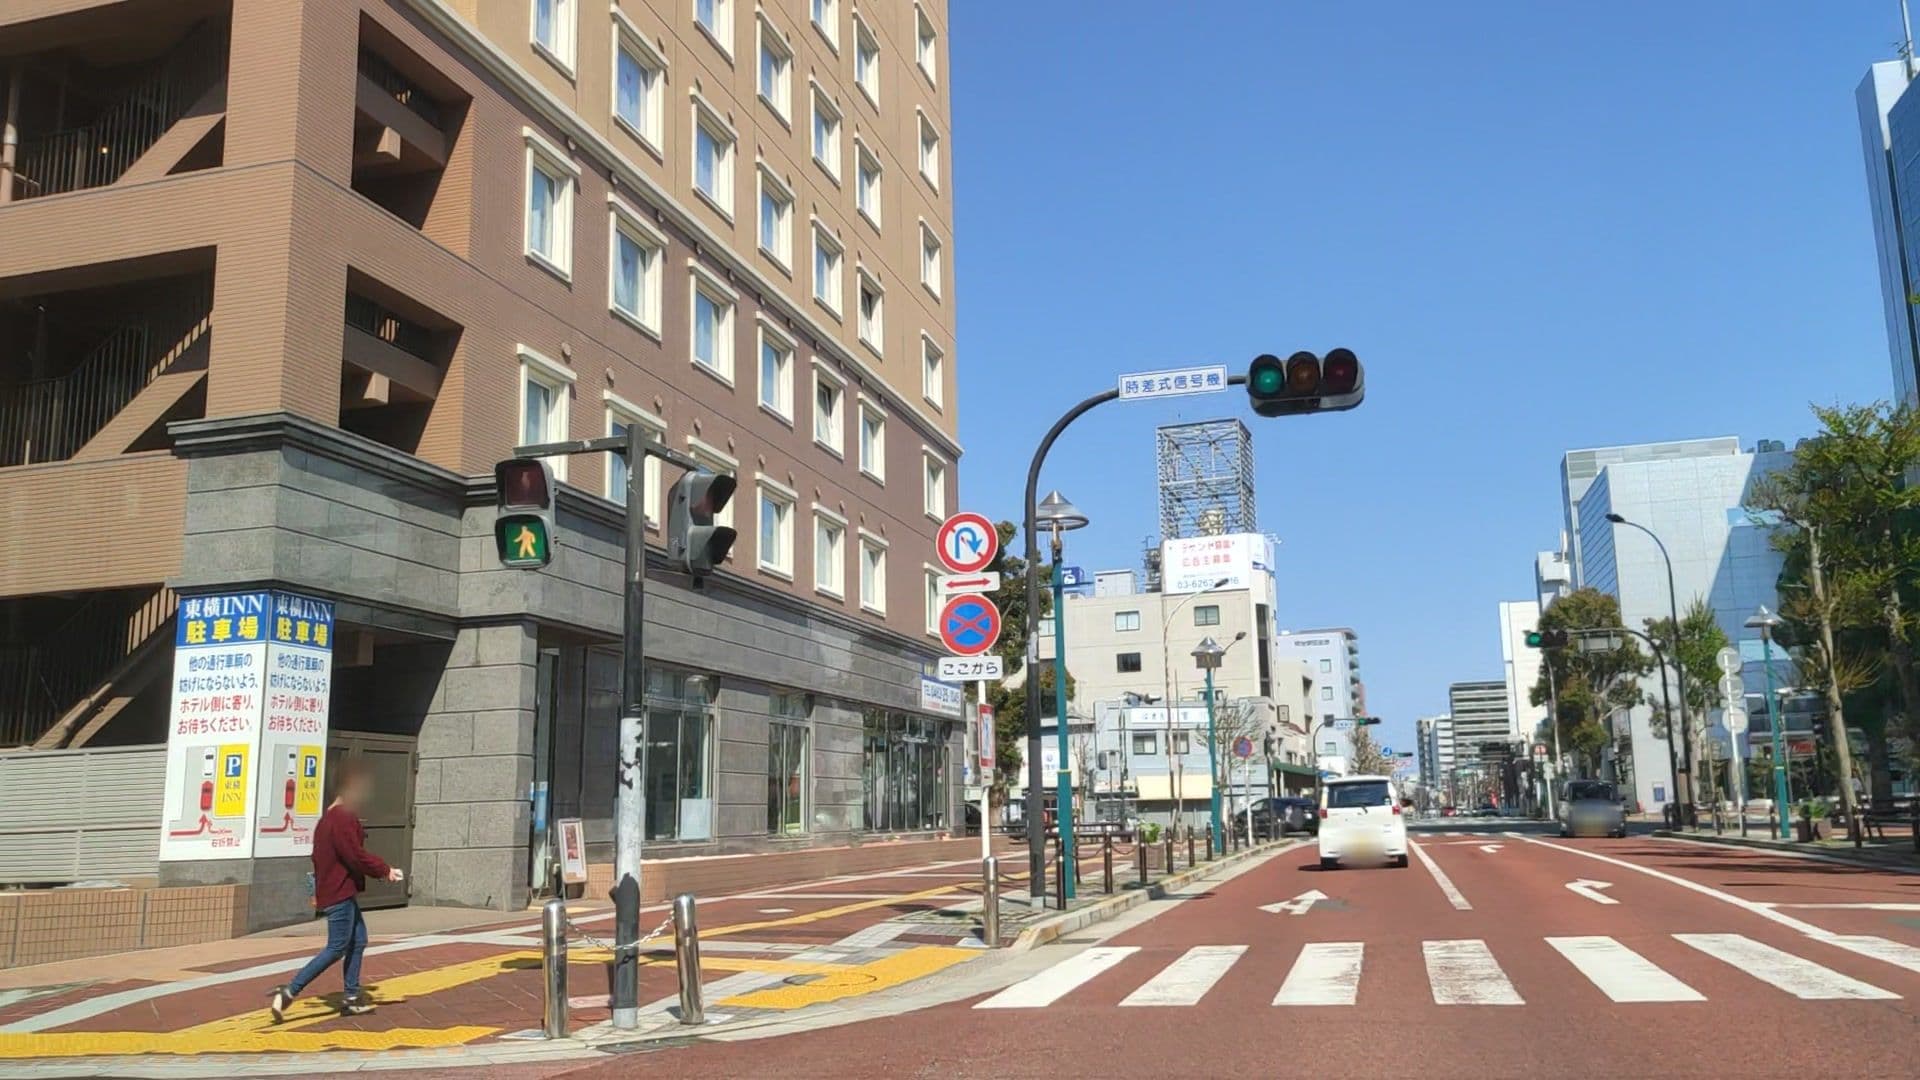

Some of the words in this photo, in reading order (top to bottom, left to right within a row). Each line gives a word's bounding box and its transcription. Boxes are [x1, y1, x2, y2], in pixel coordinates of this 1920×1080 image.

[1125, 373, 1220, 393] 時差式信号機
[184, 594, 264, 619] 東横INN
[276, 595, 331, 621] 東横INN
[186, 616, 259, 643] 駐車場
[277, 617, 328, 646] 駐車場
[944, 662, 998, 675] ここから
[227, 756, 241, 775] P
[306, 757, 316, 775] P
